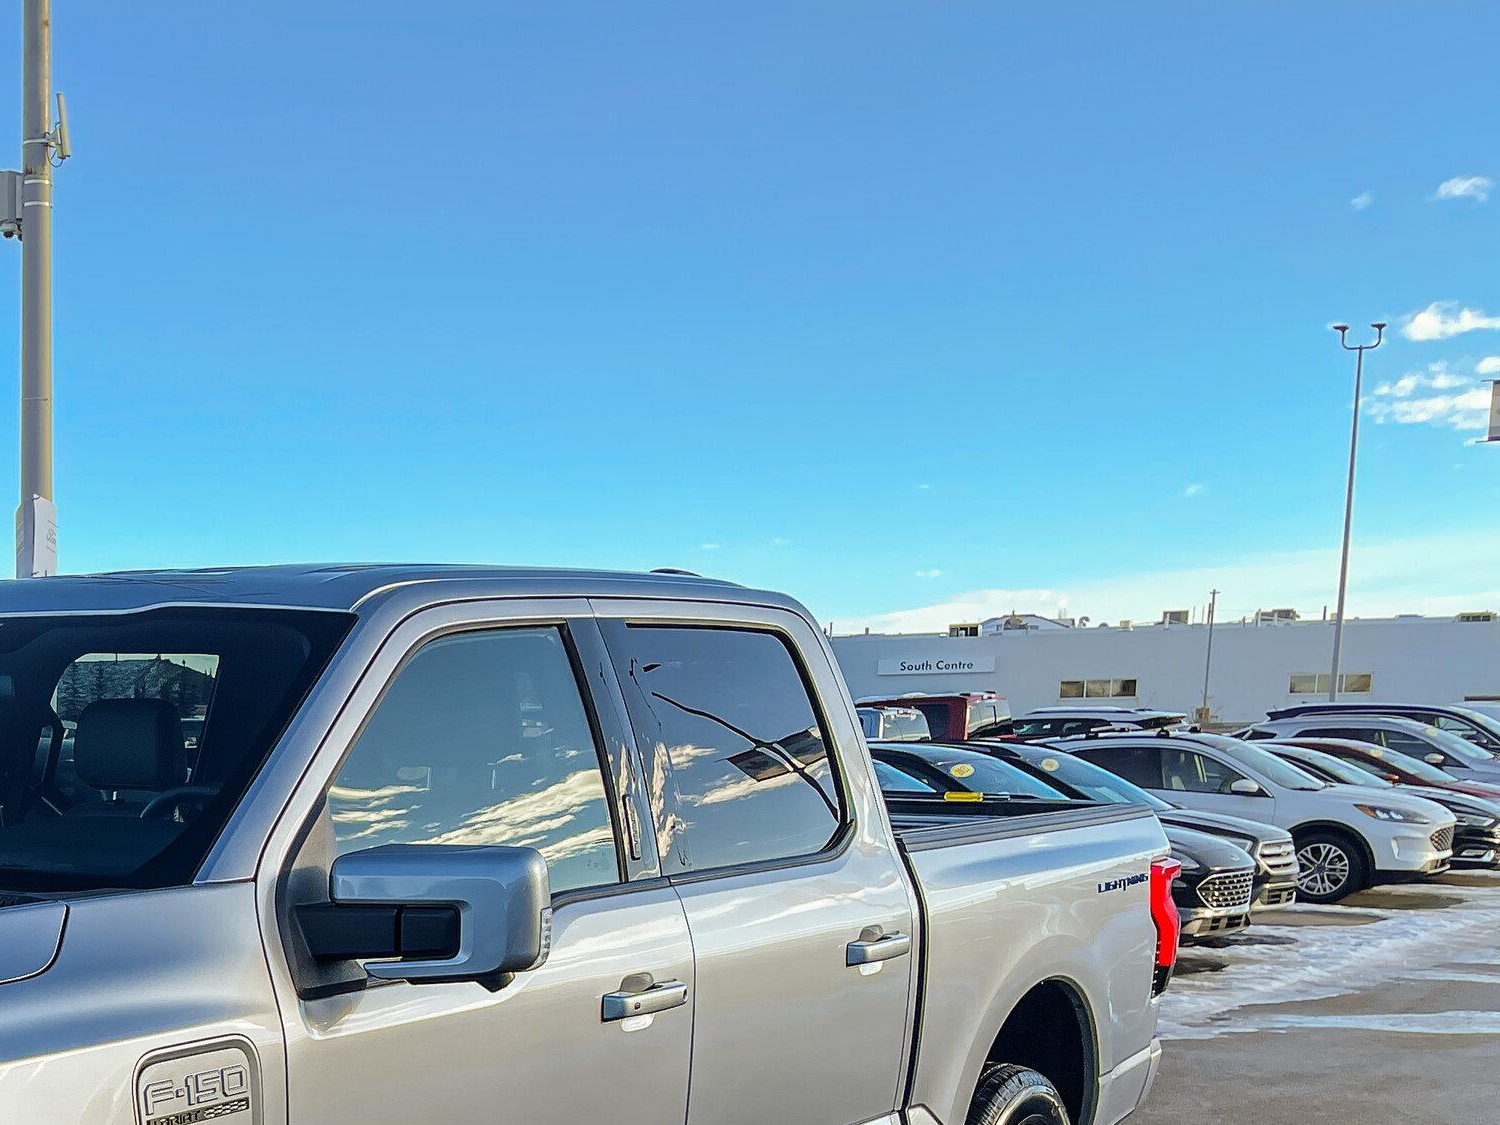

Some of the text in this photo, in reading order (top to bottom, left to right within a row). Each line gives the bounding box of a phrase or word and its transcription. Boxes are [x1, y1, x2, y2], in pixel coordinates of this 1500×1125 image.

[900, 660, 974, 671] South Centre
[143, 1064, 249, 1116] F-150
